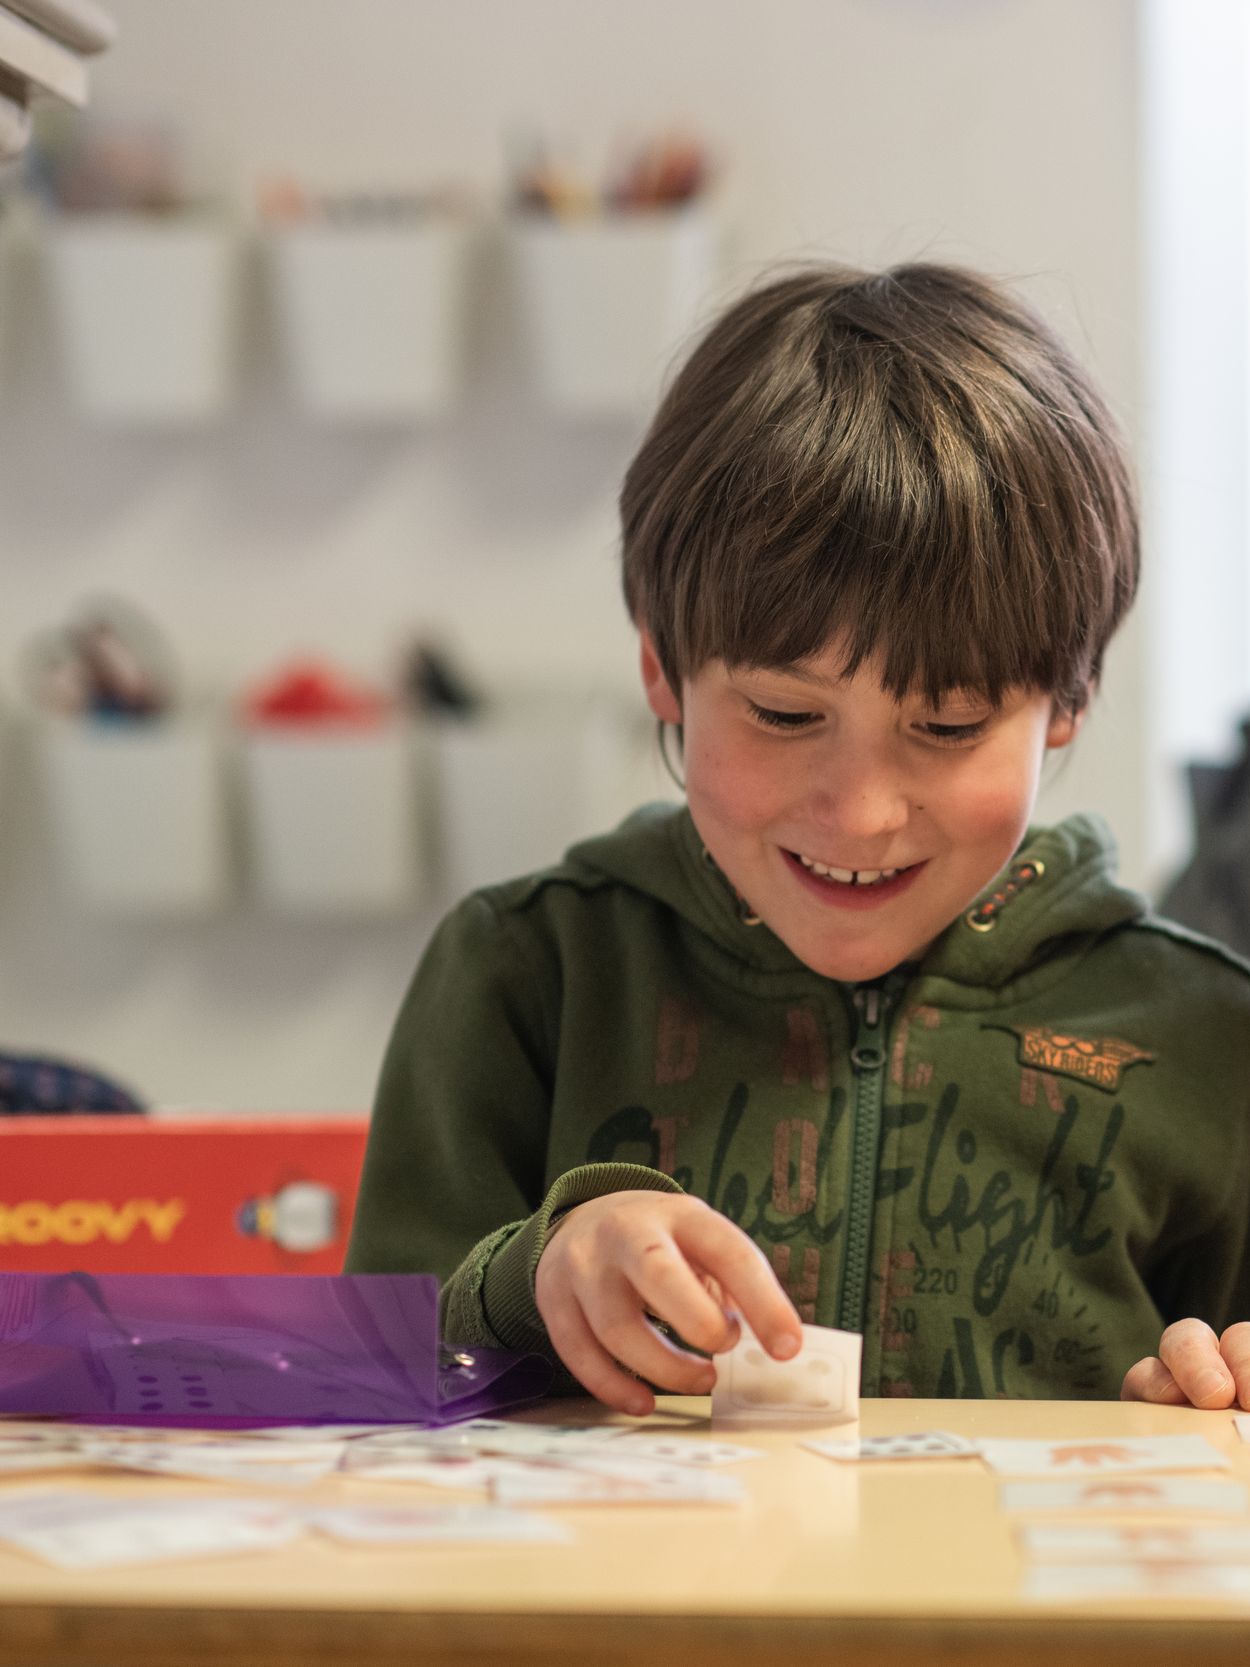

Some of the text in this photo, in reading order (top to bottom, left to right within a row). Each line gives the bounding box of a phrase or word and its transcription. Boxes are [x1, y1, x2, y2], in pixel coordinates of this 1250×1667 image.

[1024, 1038, 1115, 1083] SKY RIDERS
[876, 1082, 1124, 1316] Flight
[914, 1266, 959, 1295] 220
[1032, 1288, 1059, 1319] 40
